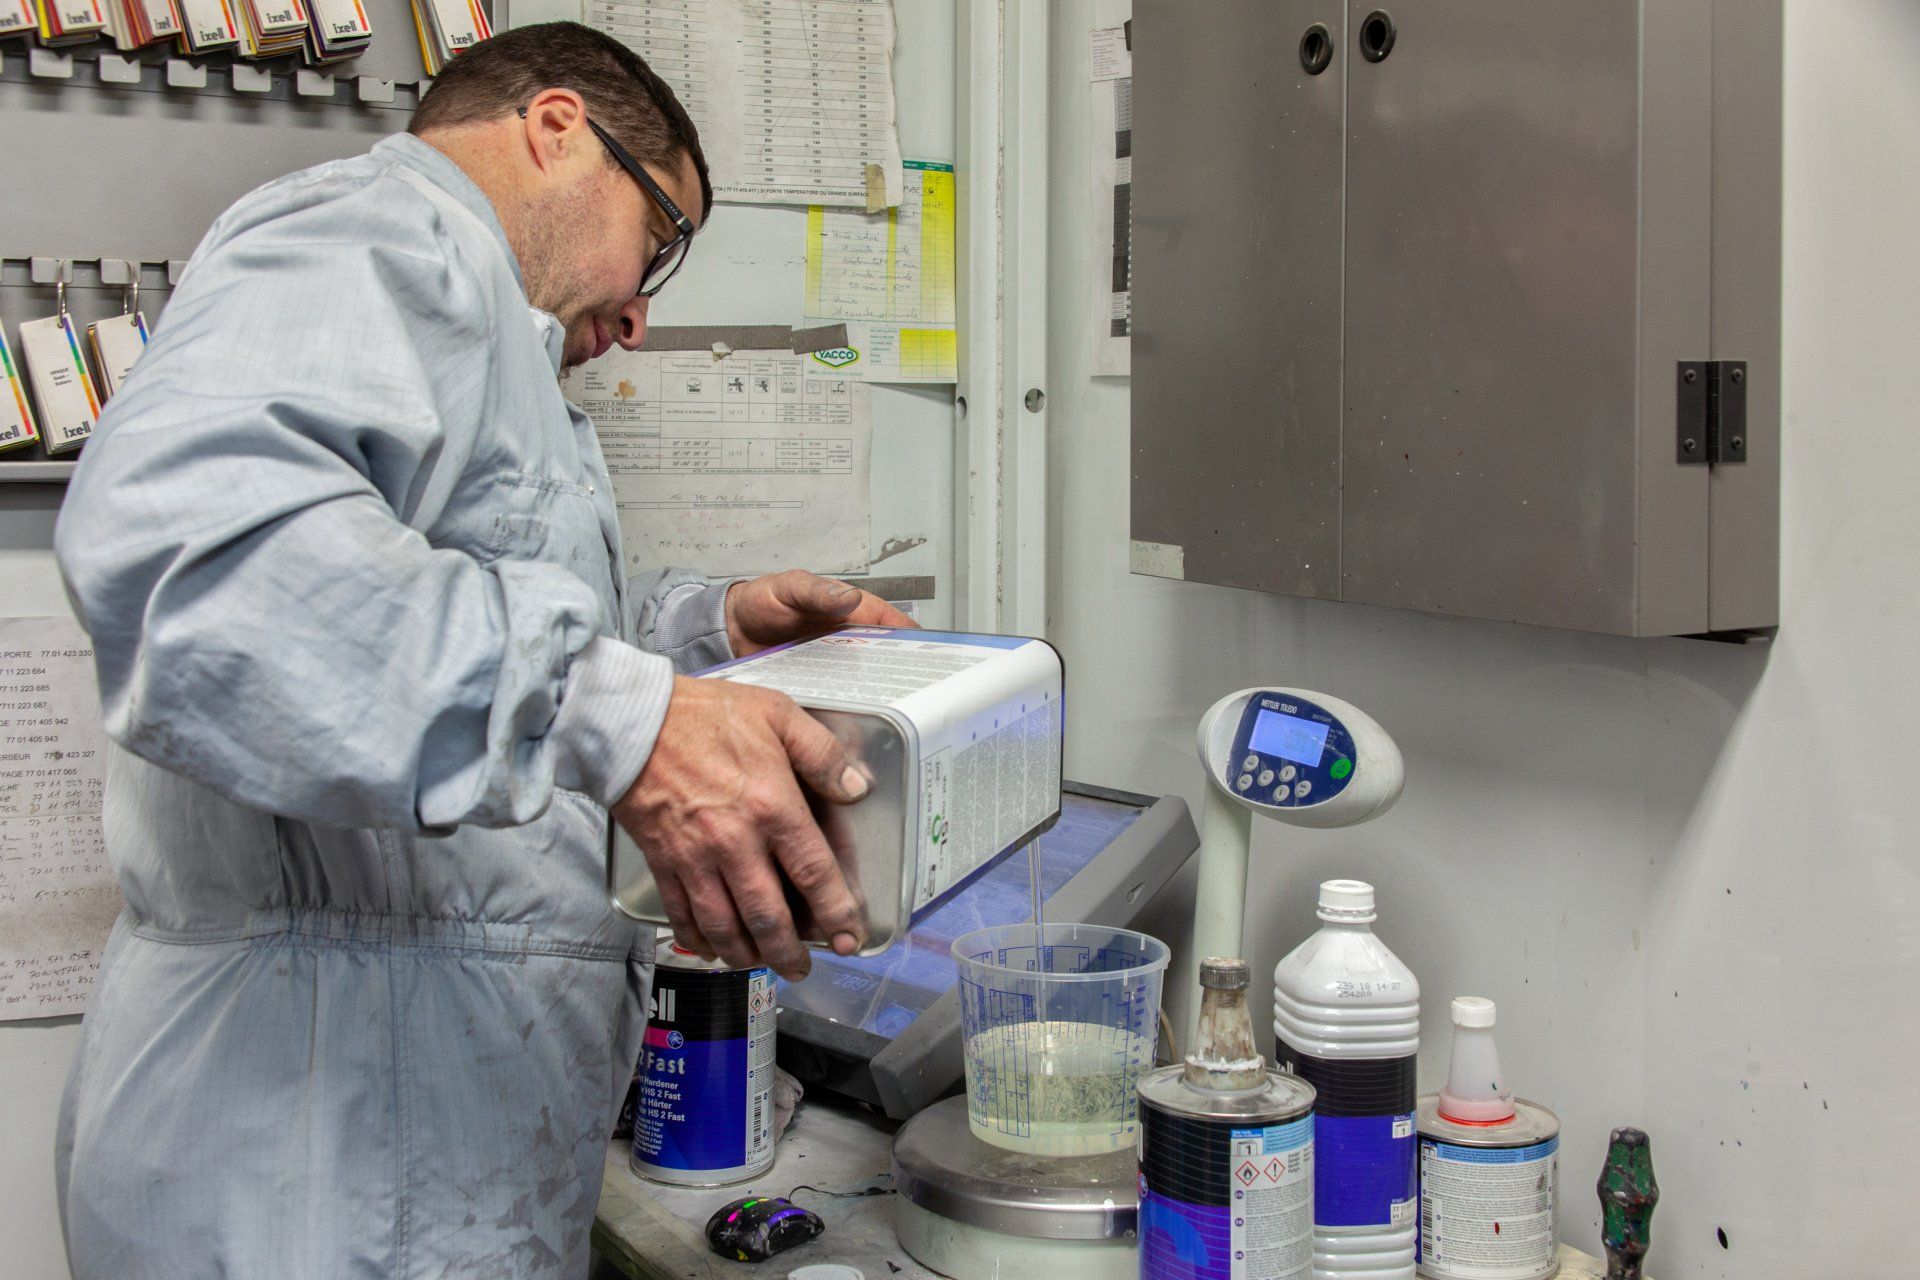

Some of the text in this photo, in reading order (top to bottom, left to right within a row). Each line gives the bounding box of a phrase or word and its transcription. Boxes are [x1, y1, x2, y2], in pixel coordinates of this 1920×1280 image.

[267, 10, 293, 23] ixell
[332, 20, 357, 34] ixell
[200, 27, 225, 42] ixell
[451, 32, 475, 45] ixell
[820, 351, 854, 360] YACCO
[63, 421, 91, 438] ixell
[1261, 699, 1298, 714] METTLER TOLEDO
[1376, 982, 1400, 990] 14:27
[647, 1051, 686, 1075] Fast
[644, 1076, 679, 1090] Hardener
[658, 1090, 662, 1098] 2
[664, 1091, 681, 1101] Fast
[648, 1109, 686, 1122] HS 2 Fast
[1246, 1145, 1251, 1155] 1
